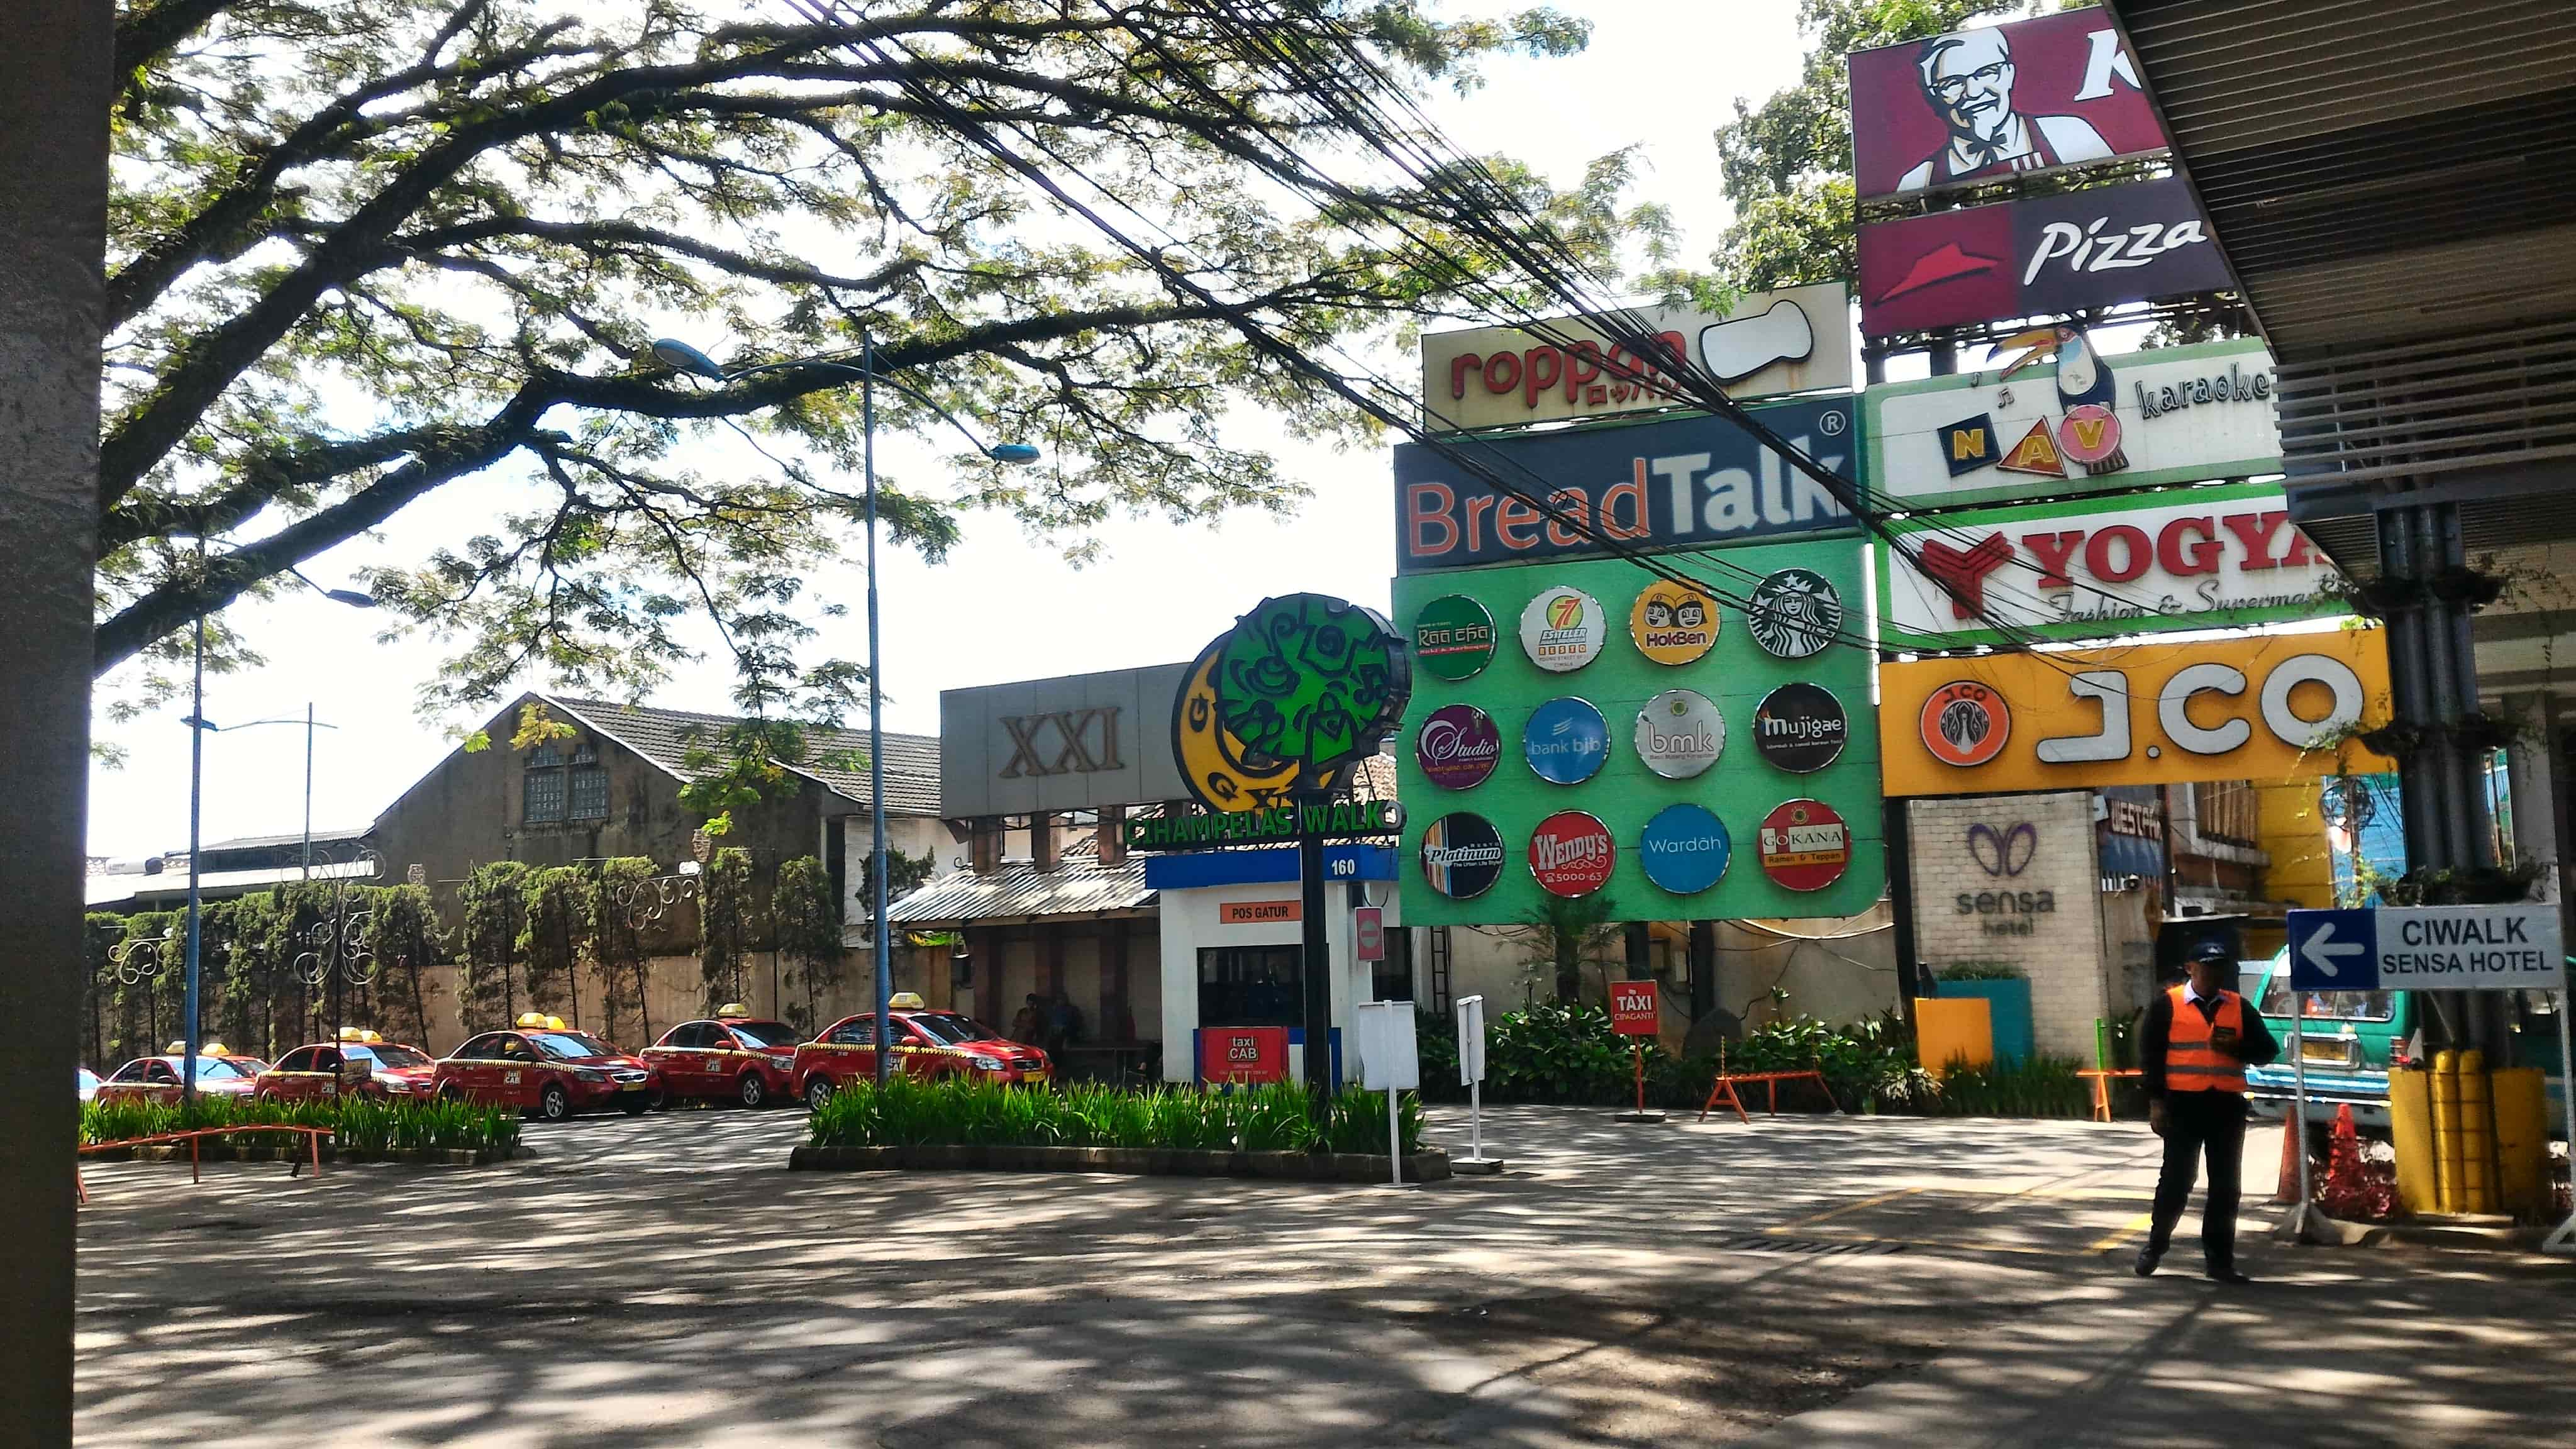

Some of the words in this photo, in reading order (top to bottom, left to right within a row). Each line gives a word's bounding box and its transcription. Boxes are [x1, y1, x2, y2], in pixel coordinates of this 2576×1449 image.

[2023, 216, 2208, 286] Pizza
[2135, 362, 2270, 420] karaoke
[1407, 434, 1852, 557] BreadTalk
[2045, 591, 2145, 625] Fashion
[2158, 594, 2183, 615] &
[2186, 579, 2312, 619] Superma
[1645, 631, 1708, 648] HokBen
[2035, 652, 2365, 765] J.CO
[997, 706, 1127, 779] XXI
[1431, 726, 1496, 766] Studio
[1531, 740, 1570, 755] bank
[1573, 736, 1601, 755] bjb
[1648, 719, 1714, 753] bmk
[1123, 805, 1294, 845] CIHAMPELAS
[1303, 801, 1384, 834] WALK
[1763, 831, 1843, 847] GOKANA
[1331, 858, 1355, 875] 160
[1428, 847, 1501, 863] Platinum
[1232, 908, 1252, 919] POS
[1255, 906, 1289, 918] GATUR
[1957, 890, 2055, 914] sensa
[1983, 916, 2034, 936] hotel
[2402, 916, 2529, 946] CIWALK
[2383, 953, 2464, 974] SENSA
[2470, 950, 2554, 972] HOTEL
[1616, 995, 1653, 1011] TAXI
[1233, 1035, 1254, 1047] taxi
[1230, 1048, 1257, 1059] CAB
